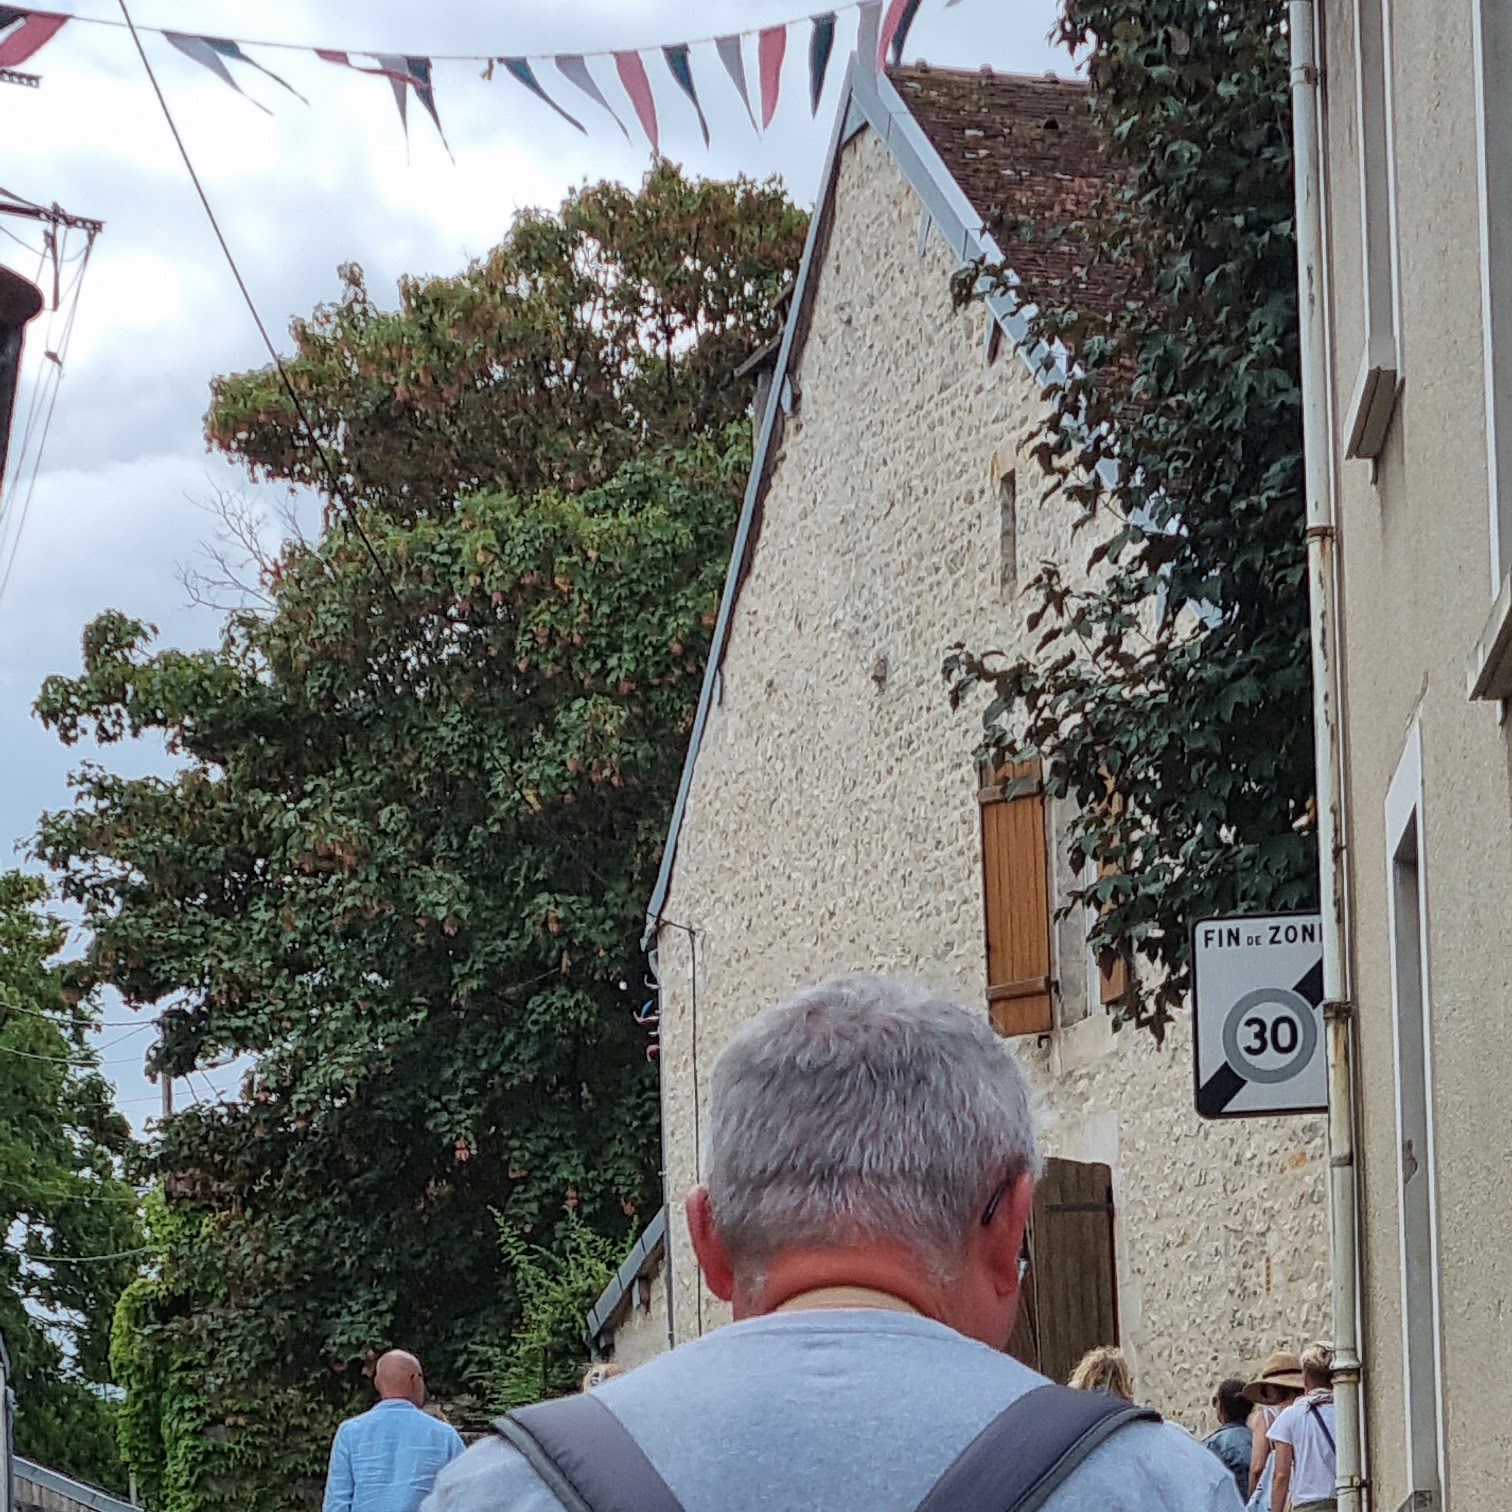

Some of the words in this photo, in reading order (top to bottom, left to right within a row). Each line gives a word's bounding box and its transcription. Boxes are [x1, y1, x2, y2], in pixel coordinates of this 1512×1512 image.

[1204, 927, 1240, 948] FIN
[1247, 935, 1262, 946] DE
[1243, 1015, 1298, 1056] 30
